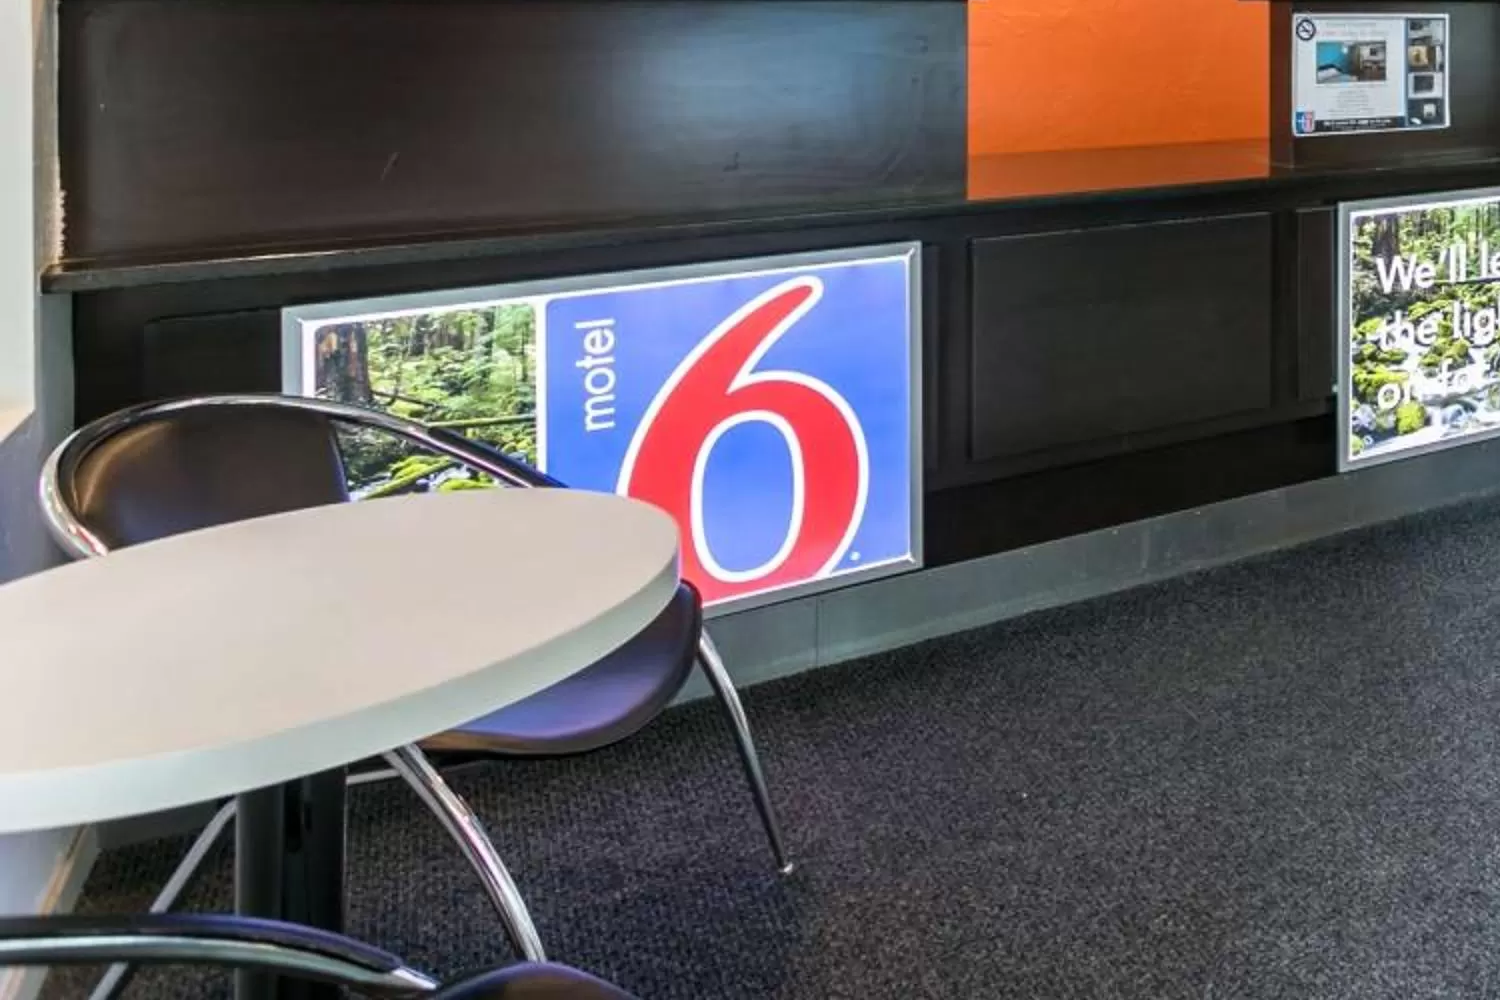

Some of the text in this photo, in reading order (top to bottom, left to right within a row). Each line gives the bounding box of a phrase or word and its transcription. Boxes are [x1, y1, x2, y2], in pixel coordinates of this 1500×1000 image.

[1376, 244, 1467, 293] We'll
[1380, 311, 1441, 351] the
[574, 275, 870, 608] motel 6
